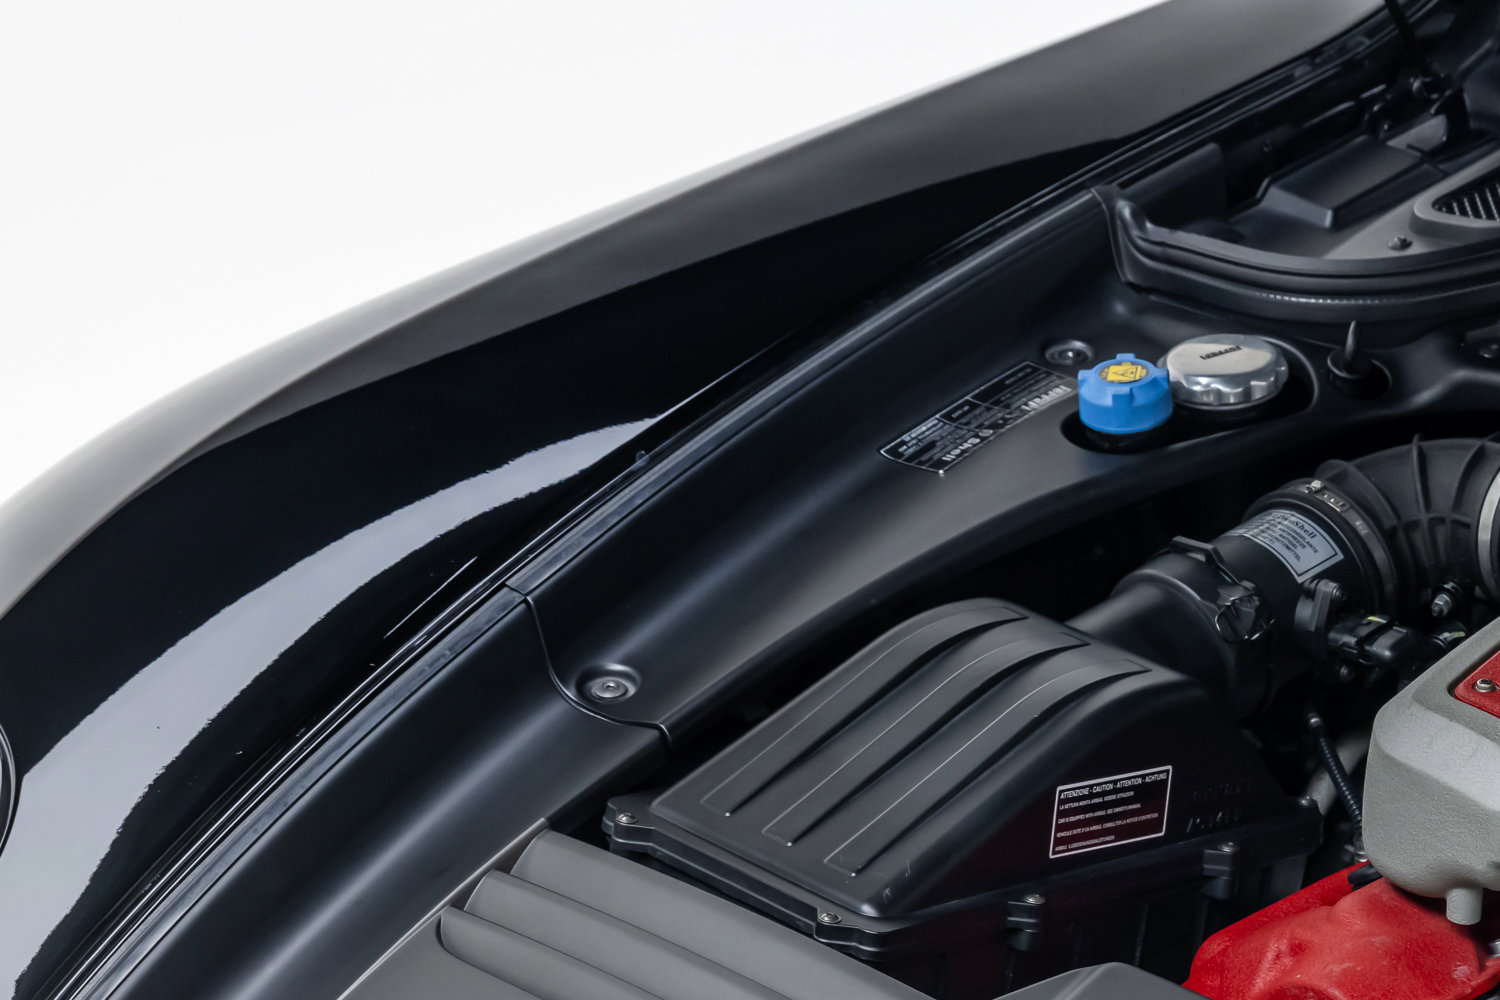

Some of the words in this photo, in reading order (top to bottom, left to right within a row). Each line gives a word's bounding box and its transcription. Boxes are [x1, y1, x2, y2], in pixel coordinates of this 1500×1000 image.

[945, 437, 981, 462] Shell
[1294, 521, 1317, 540] Shell
[1060, 787, 1089, 799] ATTENZIONE
[1093, 783, 1114, 793] CAUTION
[1117, 778, 1142, 788] ATTENTION
[1144, 773, 1167, 782] ACHTUNG
